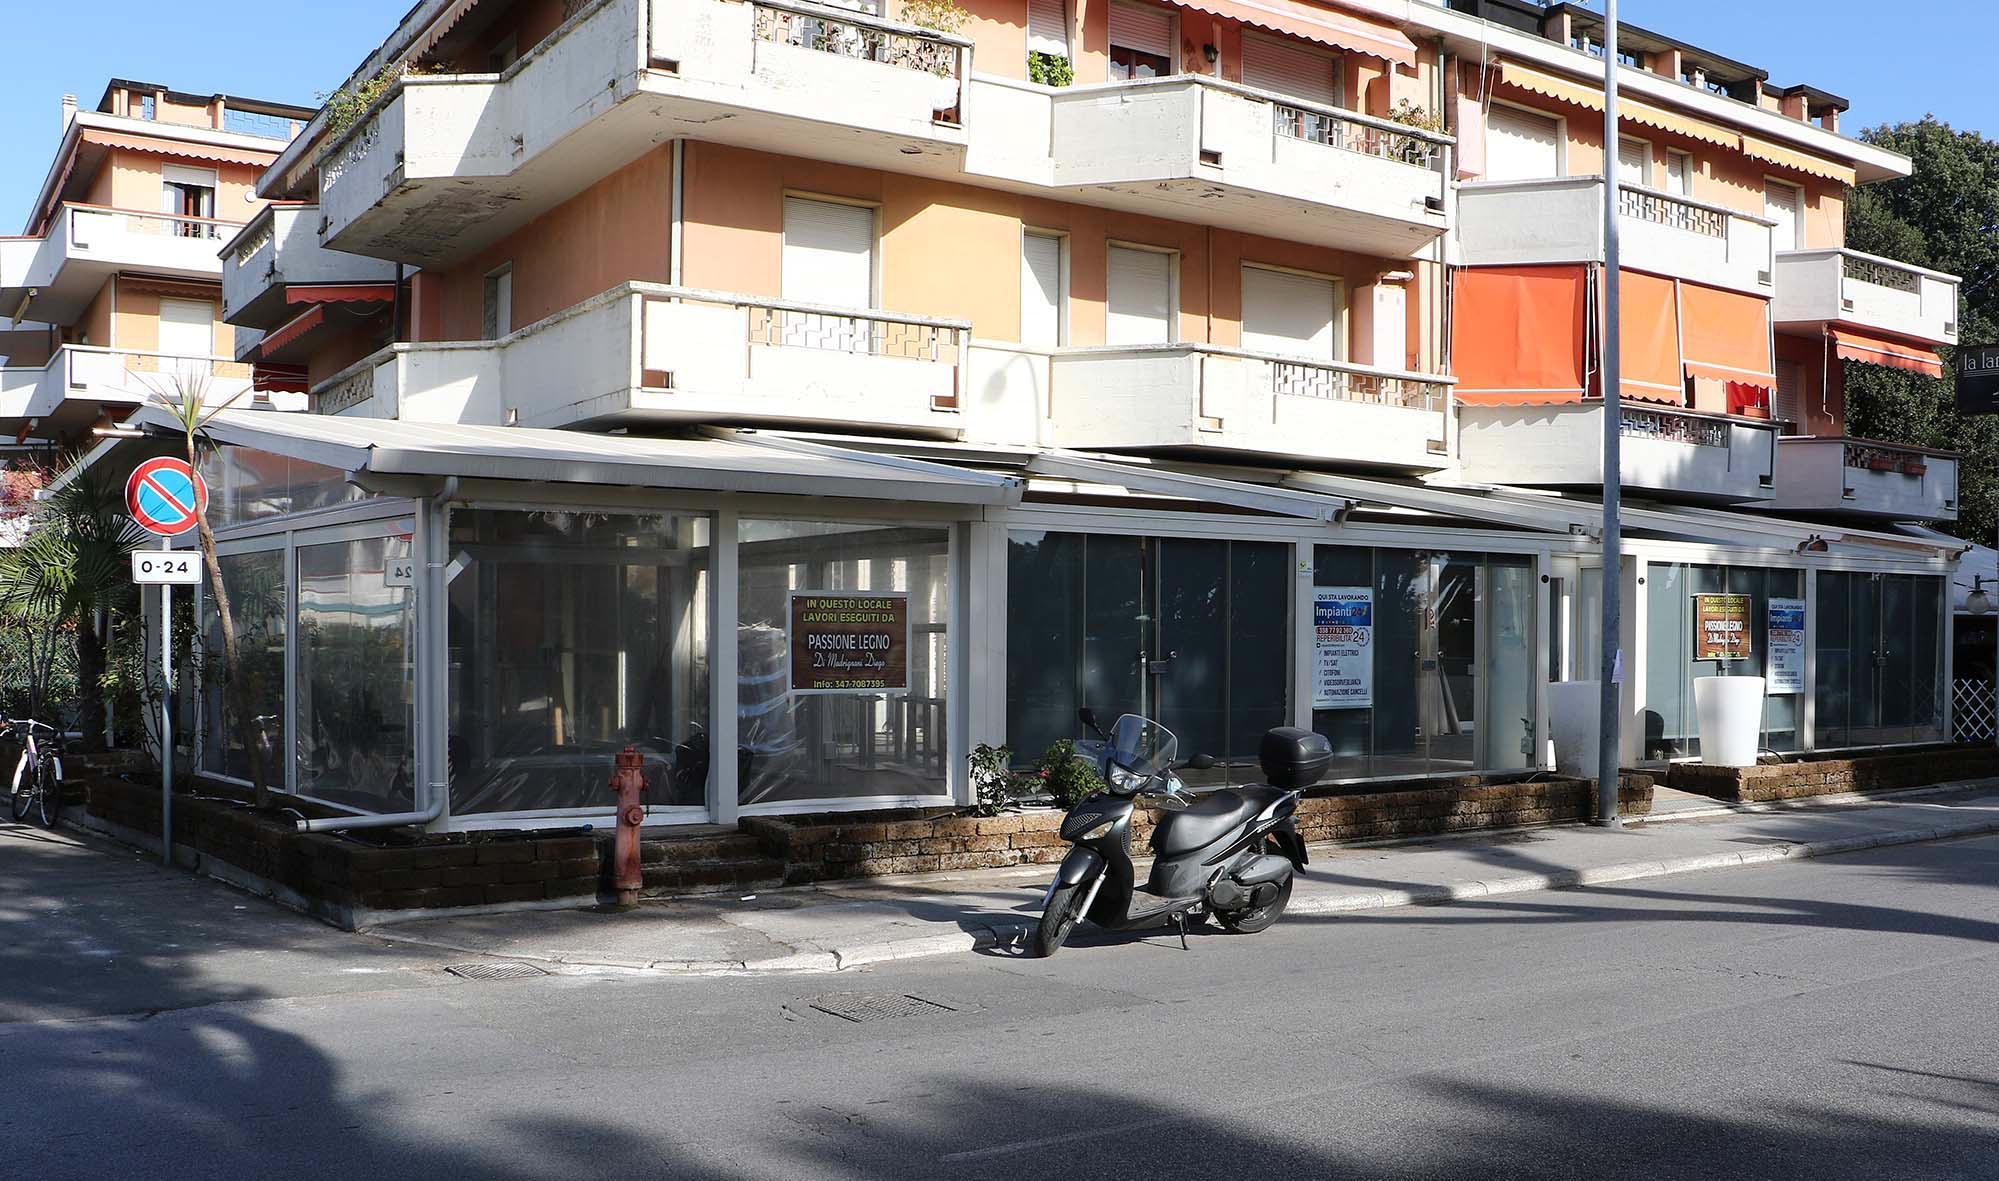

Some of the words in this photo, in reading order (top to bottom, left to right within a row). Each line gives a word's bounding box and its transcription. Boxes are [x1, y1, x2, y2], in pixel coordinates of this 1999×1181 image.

[1964, 353, 1976, 371] la
[806, 599, 817, 609] IN
[819, 599, 856, 610] QUESTO
[858, 600, 892, 609] LOCALE
[803, 612, 837, 622] LAVORI
[841, 613, 879, 622] ESEGUITI
[882, 613, 895, 622] DA
[808, 634, 856, 649] PASSIONE
[858, 634, 890, 649] LEGNO
[1353, 631, 1365, 643] 24
[813, 680, 833, 688] Info:
[835, 680, 885, 688] 347-7087395
